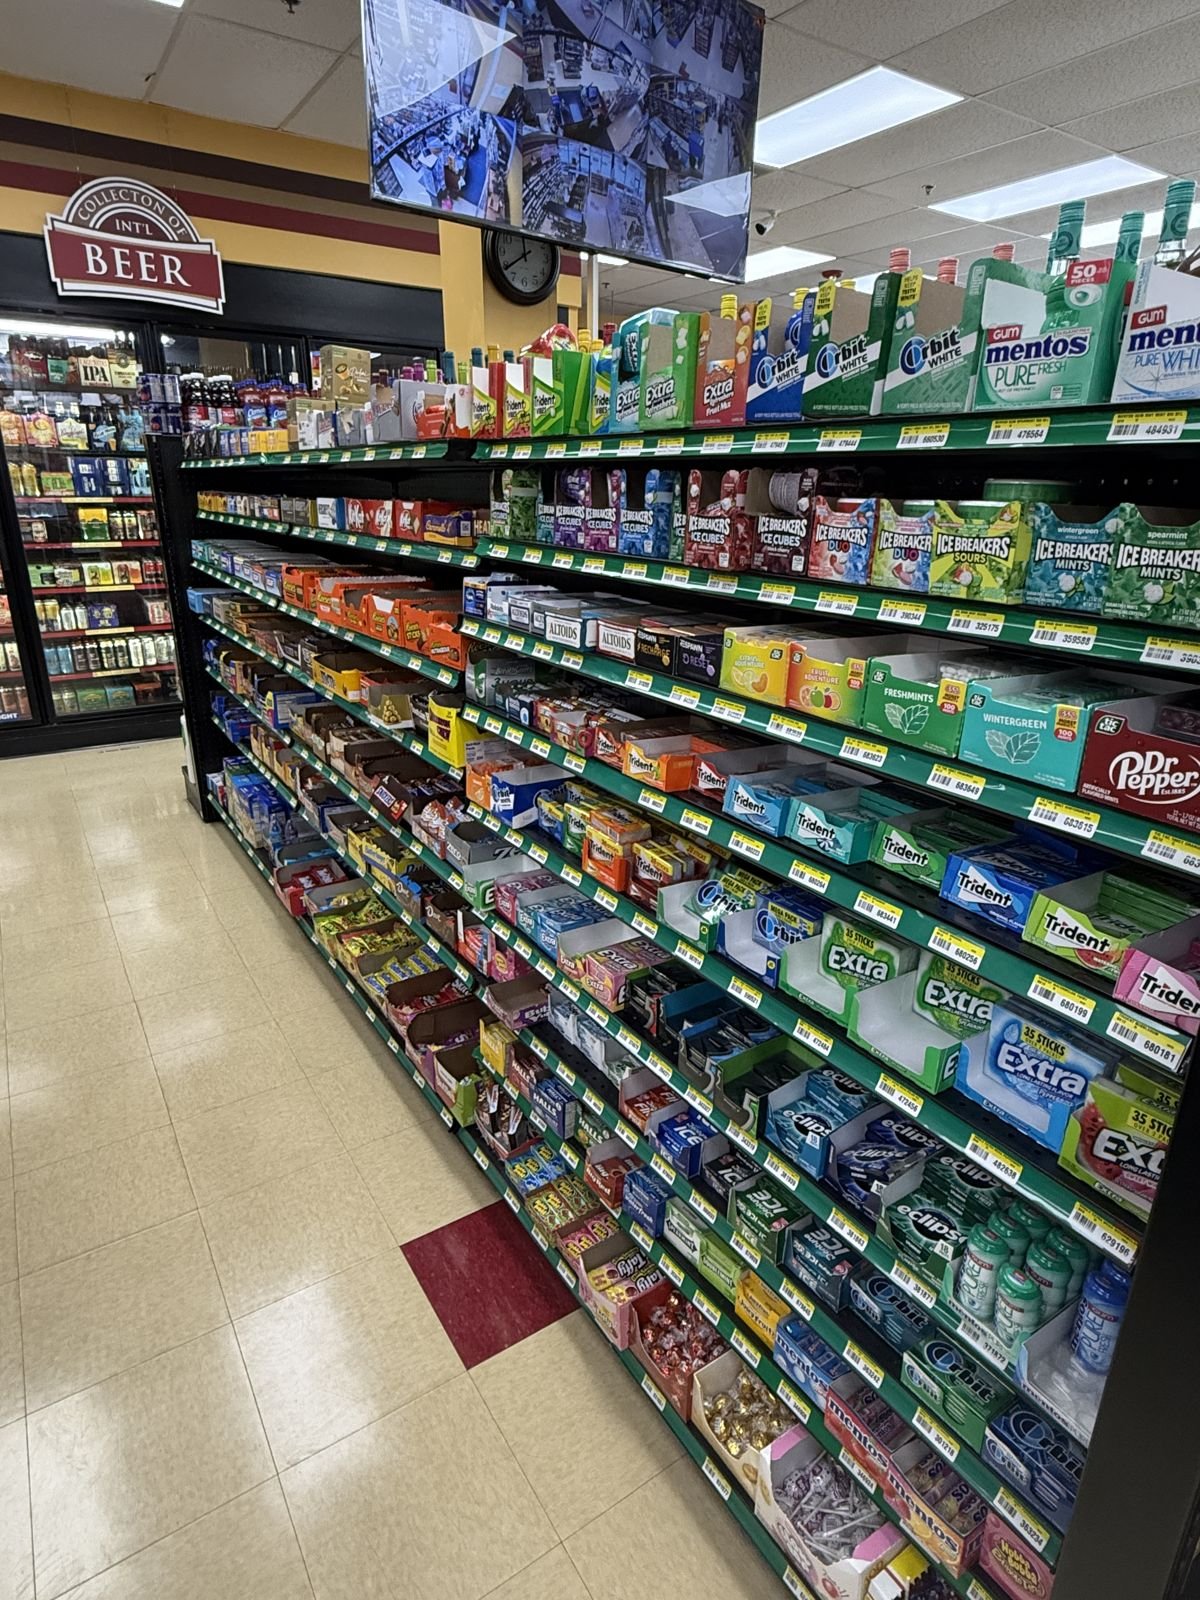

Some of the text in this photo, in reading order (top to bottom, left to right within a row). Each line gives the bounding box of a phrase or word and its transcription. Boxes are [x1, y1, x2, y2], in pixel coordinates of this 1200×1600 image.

[115, 218, 153, 236] INT'L
[169, 216, 187, 236] OF
[81, 242, 192, 287] BEER
[1070, 263, 1098, 279] 50
[510, 271, 517, 281] 7
[521, 276, 527, 287] 6
[1070, 277, 1095, 285] PIECES
[900, 293, 918, 302] WHITE
[902, 287, 917, 295] TEETH
[816, 336, 868, 379] Orbit
[900, 328, 961, 375] Orbit
[928, 347, 963, 369] WHITE
[985, 334, 1089, 365] mentos
[1134, 351, 1161, 368] PURE
[83, 365, 109, 382] IPA
[755, 348, 800, 389] Orbit
[775, 365, 800, 384] WHITE
[839, 355, 869, 374] WHITE
[994, 361, 1067, 389] PURE FRESH
[645, 379, 675, 405] Extra
[703, 377, 733, 403] Extra
[506, 399, 526, 412] Trident
[534, 395, 556, 408] Trident
[1017, 428, 1044, 439] 476564
[1145, 424, 1179, 435] 484931
[673, 512, 682, 528] ICE
[689, 516, 730, 535] ICE BREAKERS
[758, 515, 807, 538] ICE BREAKERS
[691, 533, 725, 544] ICE CUBES
[761, 533, 800, 547] ICE CUBES
[816, 524, 867, 546] ICE BREAKERS
[1057, 526, 1099, 535] wintergreen
[1147, 531, 1188, 540] spearmint
[828, 541, 850, 552] DUO
[880, 531, 931, 551] ICE BREAKER
[937, 533, 1010, 558] ICE BREAKERS
[1035, 538, 1053, 561] ICE
[893, 549, 920, 561] DUO
[954, 552, 986, 564] SOURS
[1117, 543, 1139, 568] ICE
[1055, 561, 1091, 571] MINTS
[1140, 568, 1181, 581] MINTS
[549, 621, 578, 640] ALTOIDS
[975, 622, 1000, 632] 325175
[602, 631, 632, 650] ALTOIDS
[641, 643, 671, 657] RECHARGE
[1062, 634, 1091, 646] 359588
[690, 655, 710, 669] RESET
[804, 674, 840, 684] ADVENTURE
[811, 668, 829, 677] FRUIT
[884, 687, 934, 703] FRESHMINTS
[942, 703, 955, 711] 100
[983, 713, 1047, 729] WINTERGREEN
[1099, 724, 1117, 734] tac
[1105, 718, 1120, 727] tic
[1057, 729, 1073, 737] 100
[629, 753, 652, 772] Trident
[1143, 751, 1179, 773] Dr
[697, 768, 726, 789] Trident
[1109, 751, 1200, 795] Pepper
[955, 780, 980, 795] 683649
[733, 790, 766, 815] Trident
[798, 812, 836, 840] Trident
[1064, 817, 1094, 833] 683615
[589, 838, 614, 861] Trident
[883, 836, 929, 866] Trident
[636, 855, 662, 882] Trident
[722, 876, 745, 894] MEGA PACK
[959, 872, 1012, 907] Trident
[770, 904, 798, 924] MEGA PACK
[877, 909, 897, 924] 683441
[845, 928, 874, 949] 35 STICKS
[1046, 913, 1111, 952] Trident
[597, 948, 639, 970] Extra
[828, 945, 888, 981] Extra
[954, 948, 978, 965] 680256
[587, 977, 604, 991] Extra
[946, 962, 981, 986] 35 STICKS
[924, 978, 994, 1021] Extra
[1060, 998, 1088, 1018] 680199
[1024, 1026, 1066, 1057] 35 STICKS
[1143, 1036, 1175, 1062] 680181
[512, 1060, 530, 1081] HALLS
[997, 1043, 1087, 1095] Extra
[1017, 1072, 1074, 1099] LONG LASTING FLAVOR
[534, 1092, 557, 1117] HALLS
[898, 1095, 919, 1112] 472456
[983, 1099, 1004, 1115] Extra
[1132, 1110, 1148, 1124] 35
[579, 1116, 603, 1144] HALLS
[673, 1125, 703, 1146] ICE
[1134, 1123, 1149, 1133] OVER
[844, 1148, 907, 1163] eclipse
[992, 1160, 1018, 1180] 482638
[1120, 1161, 1138, 1173] LONG
[586, 1167, 611, 1196] Big Red
[752, 1189, 788, 1214] ICE
[1095, 1183, 1121, 1202] Extra
[810, 1228, 850, 1256] ICE
[940, 1243, 950, 1253] 18
[1101, 1232, 1130, 1257] 629196
[617, 1251, 649, 1277] Taffy
[963, 1260, 981, 1298] PURE
[866, 1276, 929, 1329] Orbit
[912, 1282, 933, 1305] 381871
[1082, 1311, 1106, 1352] PURE
[983, 1343, 1006, 1363] 371872
[777, 1335, 829, 1393] mentos
[862, 1363, 881, 1384] 363242
[924, 1340, 996, 1404] Orbit
[829, 1400, 889, 1468] mentos
[934, 1432, 955, 1456] 301218
[889, 1472, 959, 1551] mentos
[1019, 1519, 1043, 1546] 363234
